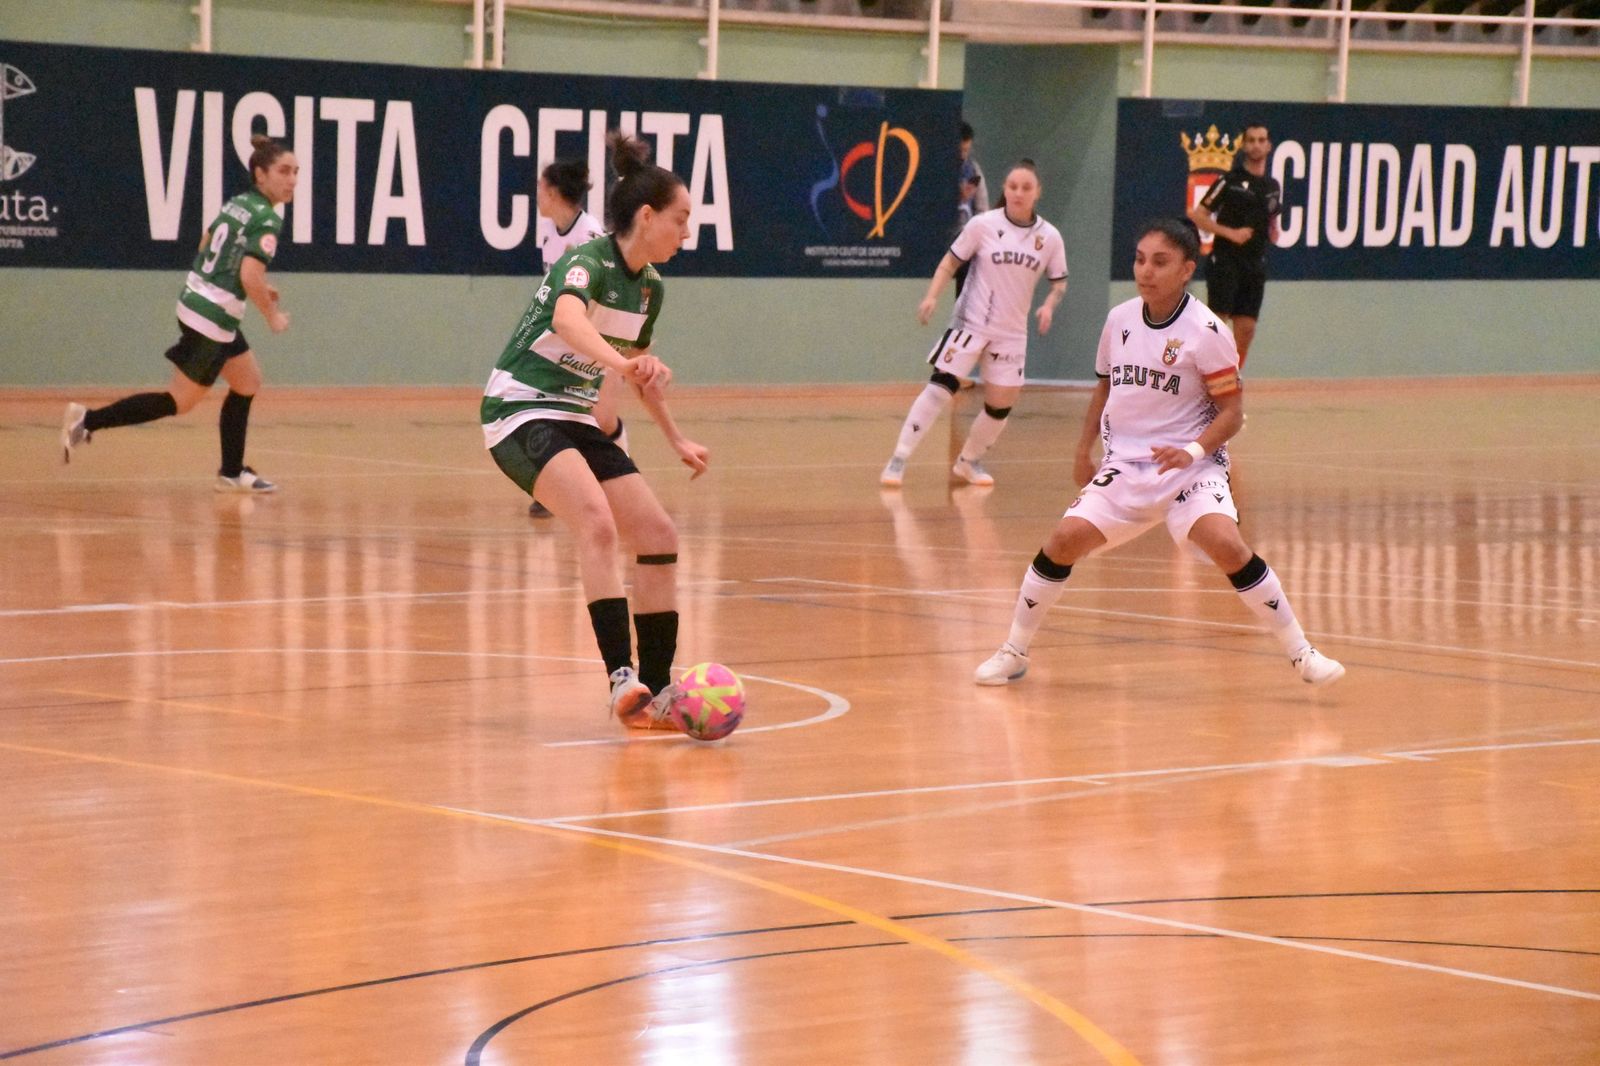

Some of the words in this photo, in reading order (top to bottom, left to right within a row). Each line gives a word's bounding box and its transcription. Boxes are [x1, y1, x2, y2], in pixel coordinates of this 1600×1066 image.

[134, 87, 426, 246] VISITA
[1272, 140, 1476, 249] CIUDAD
[202, 222, 229, 274] 9
[953, 330, 973, 349] 11
[1112, 365, 1181, 395] CEUTA
[1092, 467, 1121, 488] 3
